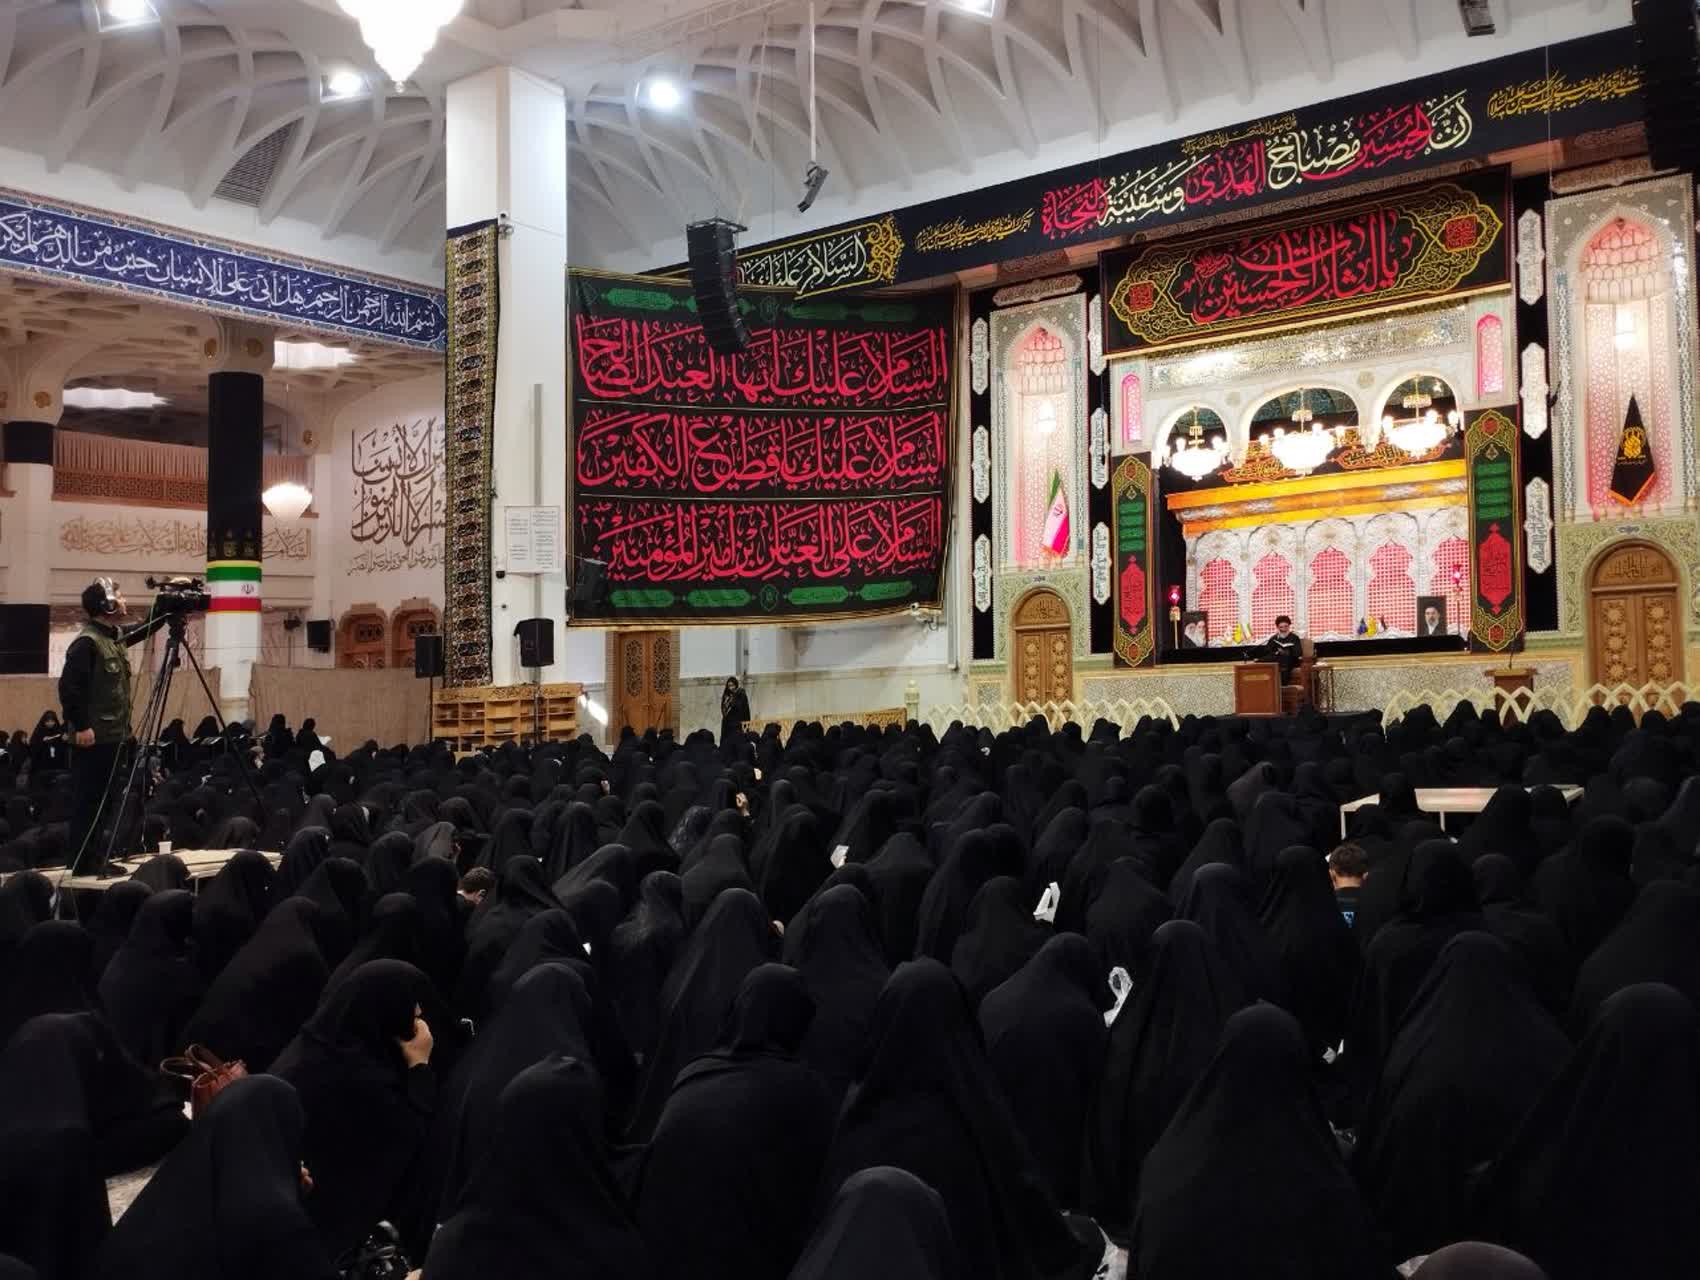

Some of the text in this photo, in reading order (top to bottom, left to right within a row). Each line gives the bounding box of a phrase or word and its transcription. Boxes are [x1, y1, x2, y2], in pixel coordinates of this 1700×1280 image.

[1267, 120, 1361, 190] مصباح
[770, 328, 868, 405] عليك
[862, 327, 948, 403] السلام
[781, 416, 872, 490] عليك
[864, 411, 947, 490] السلام
[868, 497, 942, 573] السلام
